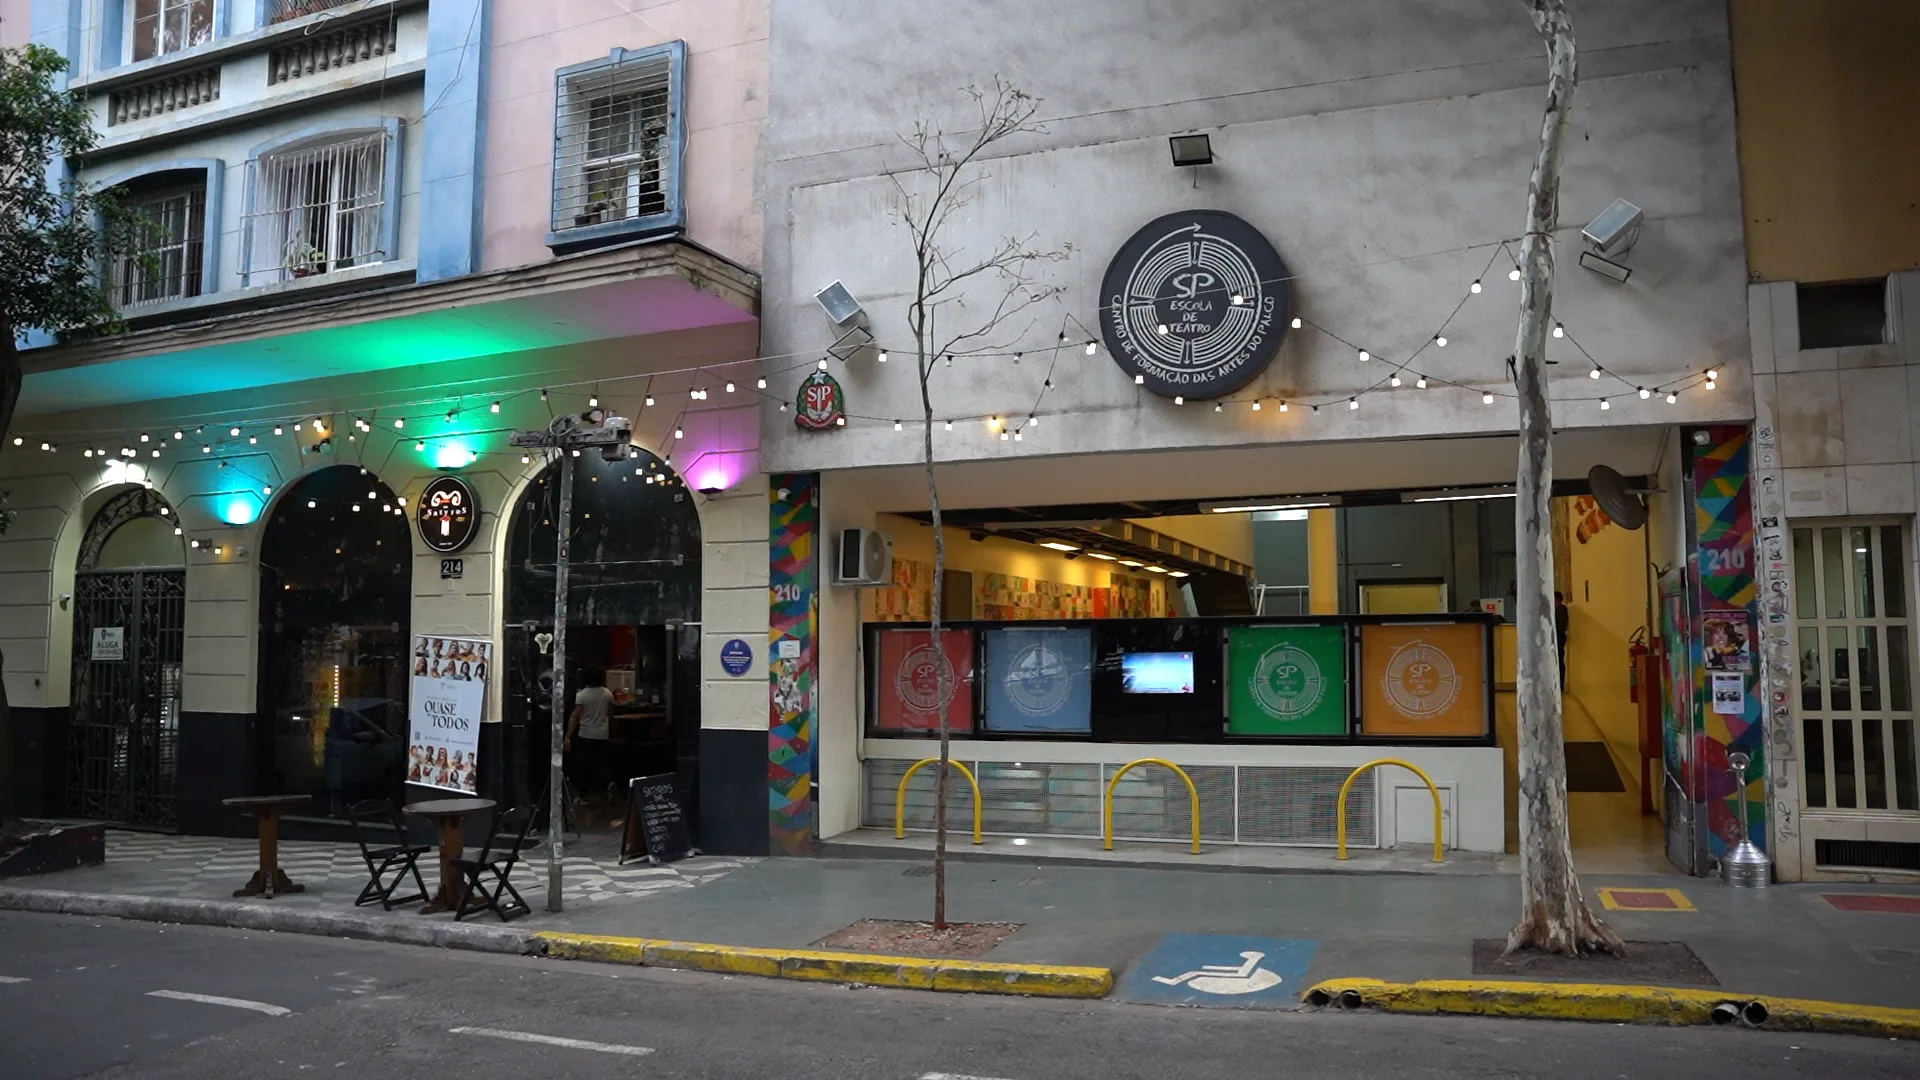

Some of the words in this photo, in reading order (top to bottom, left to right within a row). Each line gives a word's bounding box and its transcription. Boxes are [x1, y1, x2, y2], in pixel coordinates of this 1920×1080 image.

[1172, 273, 1215, 299] SP
[1170, 300, 1213, 311] ESCOLA
[1182, 311, 1198, 322] DE
[1169, 323, 1211, 334] TEATRO
[1111, 294, 1126, 338] CENTRO
[1121, 341, 1133, 354] DE
[1193, 371, 1216, 384] DAS
[1219, 352, 1251, 377] ARTES
[1249, 336, 1263, 352] DO
[1257, 296, 1275, 336] PALCO
[1707, 548, 1746, 570] 210
[442, 561, 462, 573] 214
[774, 584, 800, 602] 210
[1276, 665, 1298, 679] SP
[1409, 663, 1431, 678] SP
[424, 700, 457, 716] QUASE
[432, 714, 469, 731] TODOS
